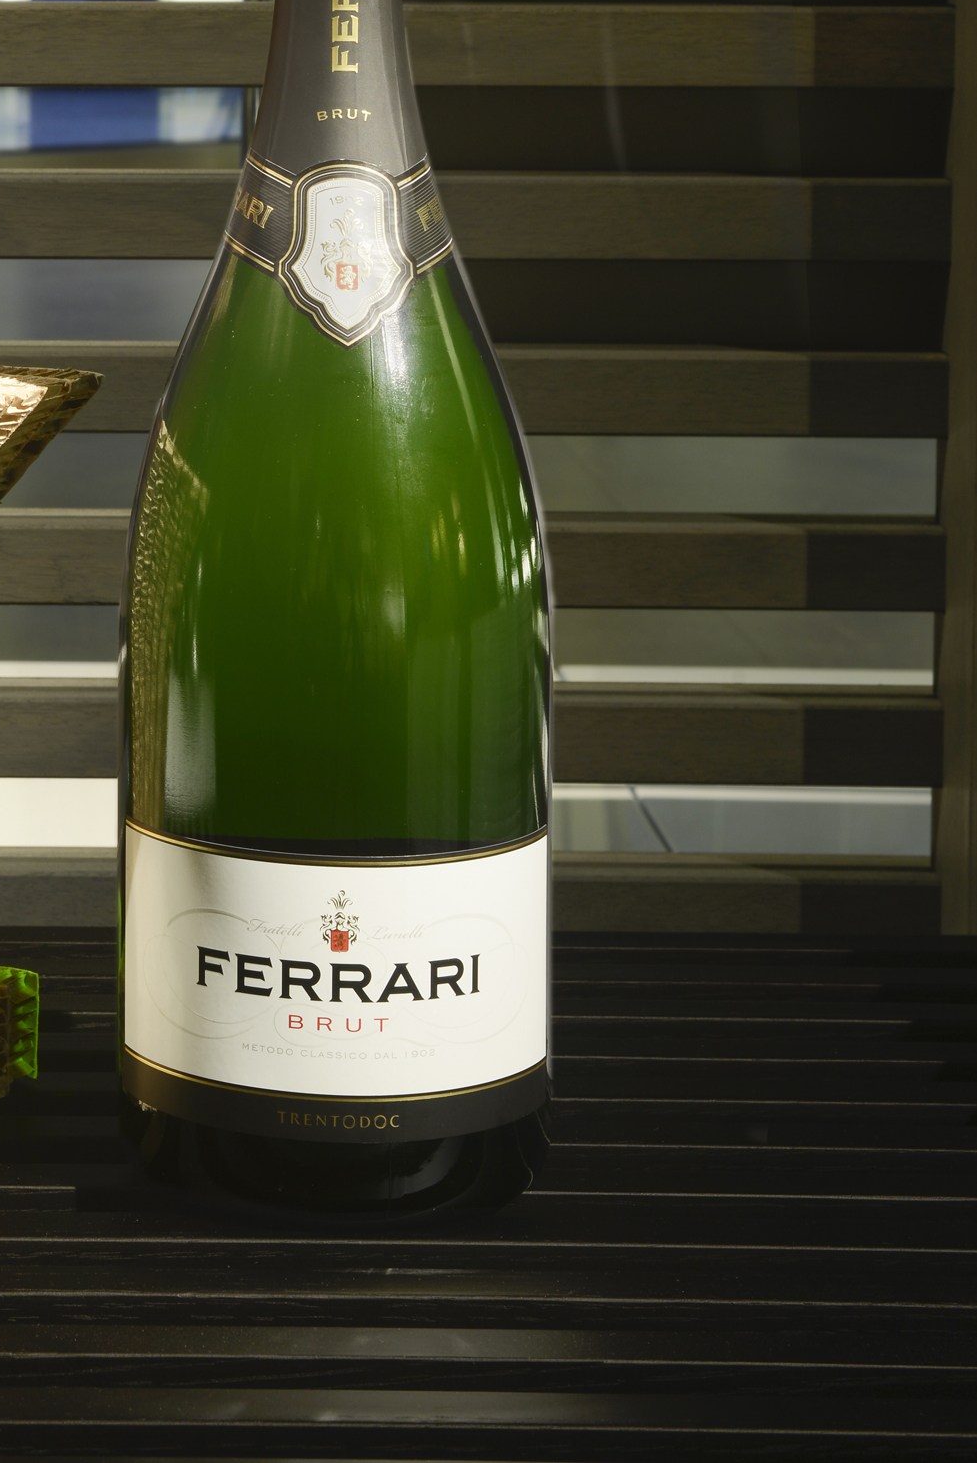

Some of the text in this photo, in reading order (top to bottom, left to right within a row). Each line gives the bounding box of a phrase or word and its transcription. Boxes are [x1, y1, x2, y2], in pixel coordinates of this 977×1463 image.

[316, 108, 372, 122] BRUT
[329, 195, 364, 207] 1902
[247, 918, 305, 938] Fratelli
[196, 945, 482, 1003] FERRARI
[288, 1014, 390, 1033] BRUT
[241, 1042, 436, 1060] METODO CLASSICO DAL 1902
[277, 1110, 401, 1129] TRENTODOC
